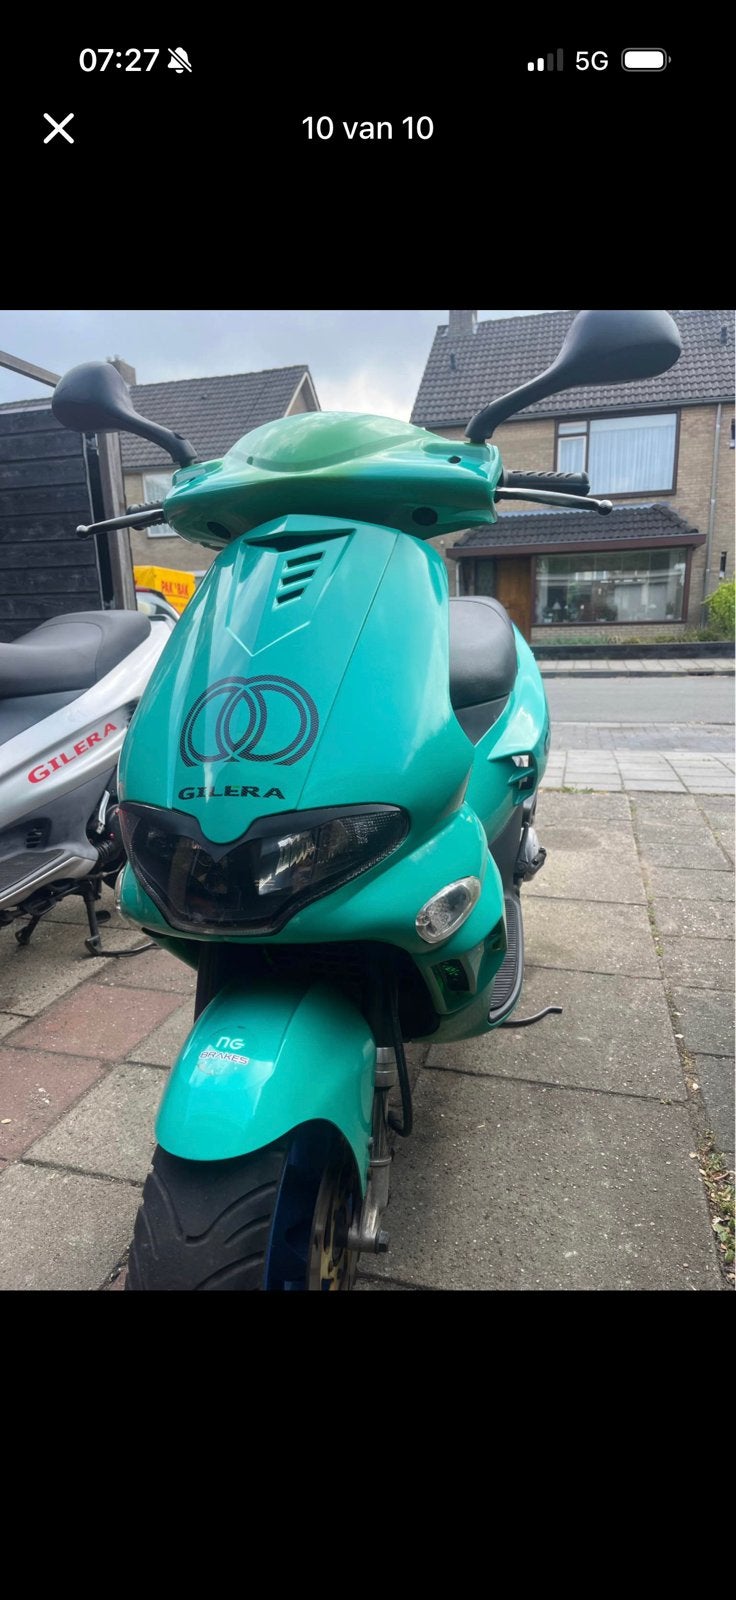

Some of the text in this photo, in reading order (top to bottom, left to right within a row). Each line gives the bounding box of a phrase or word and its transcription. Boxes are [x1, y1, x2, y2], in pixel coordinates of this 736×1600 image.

[28, 723, 117, 784] GILERA
[178, 785, 285, 801] GILERA
[200, 1050, 249, 1065] BRAKES
